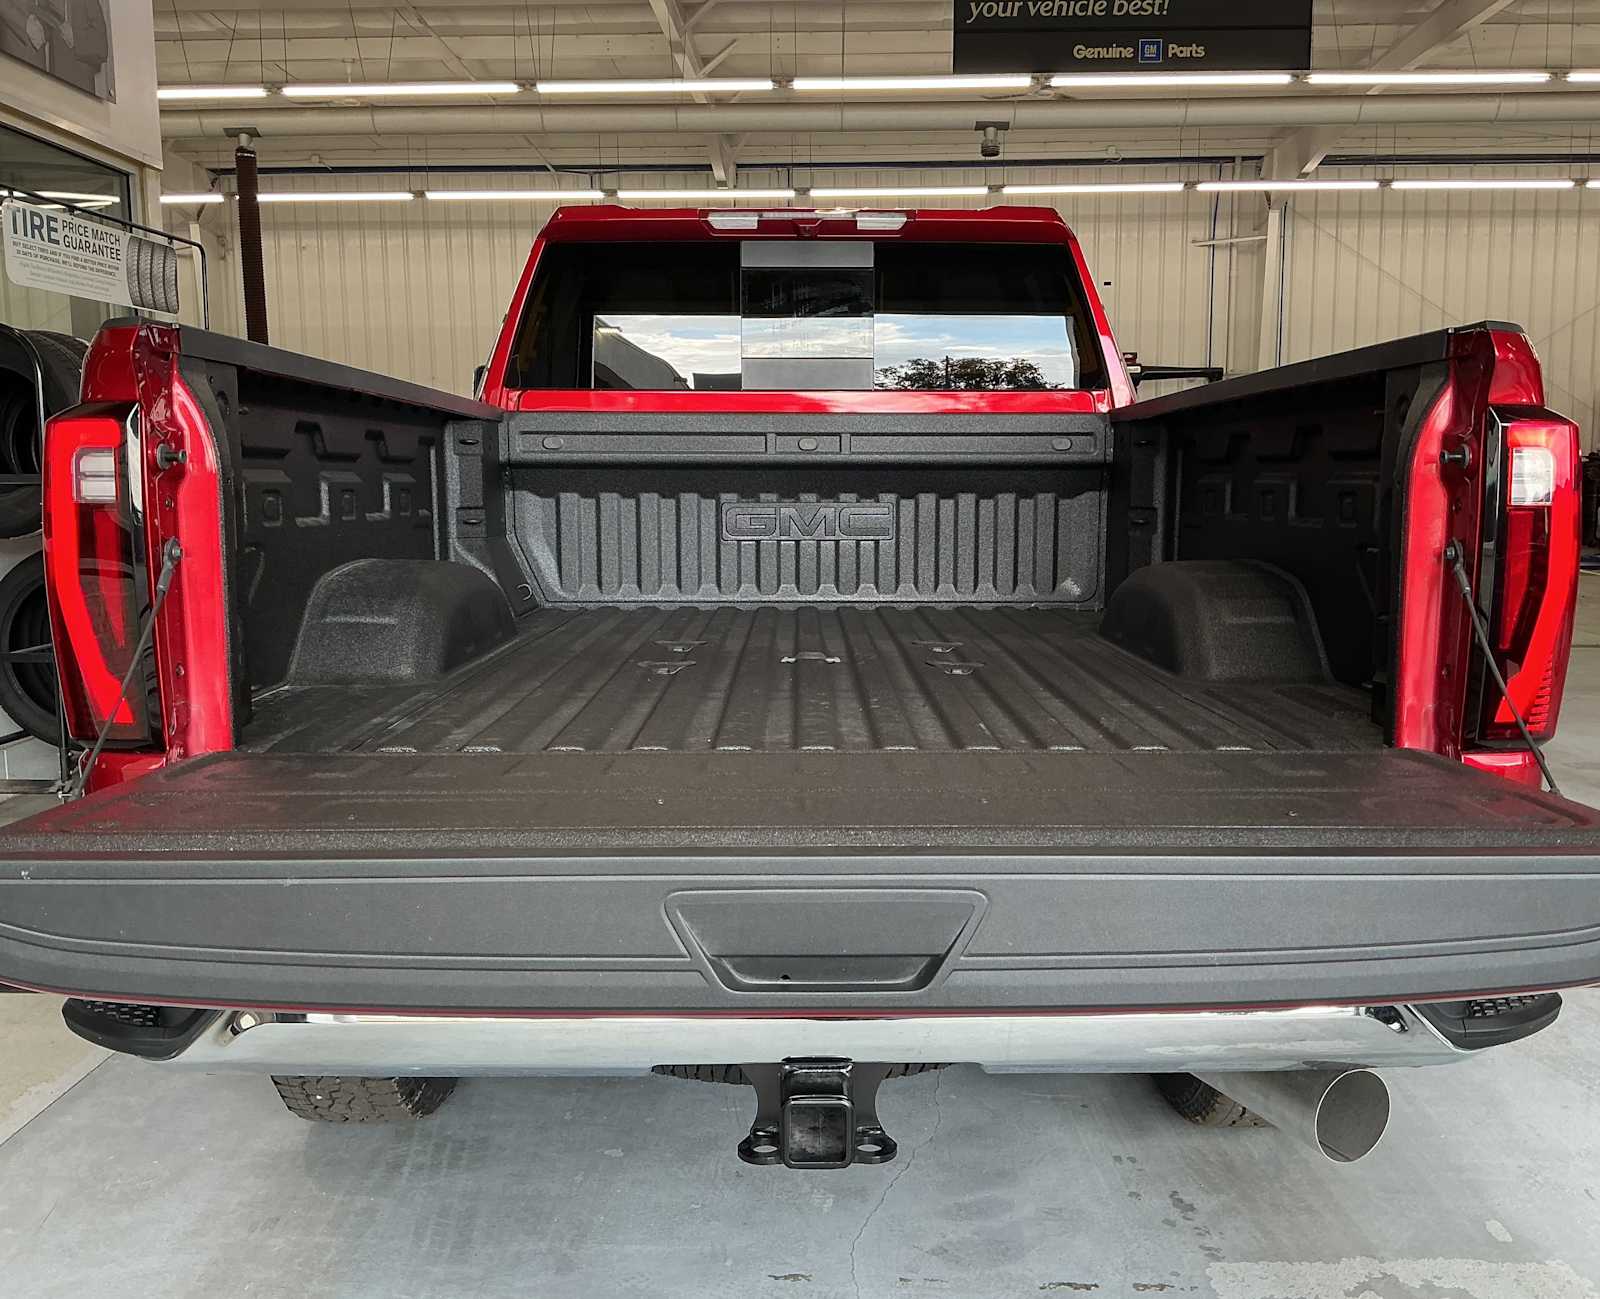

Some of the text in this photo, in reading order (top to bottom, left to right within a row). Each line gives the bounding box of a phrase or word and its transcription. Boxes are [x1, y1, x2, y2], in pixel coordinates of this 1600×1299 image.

[966, 0, 1169, 23] your vehicle best!
[1073, 43, 1134, 59] Genuine
[1168, 43, 1205, 58] Parts
[9, 205, 60, 245] TIRE
[62, 219, 120, 247] PRICE MATCH
[63, 234, 121, 261] GUARANTEE
[726, 506, 890, 537] GMC
